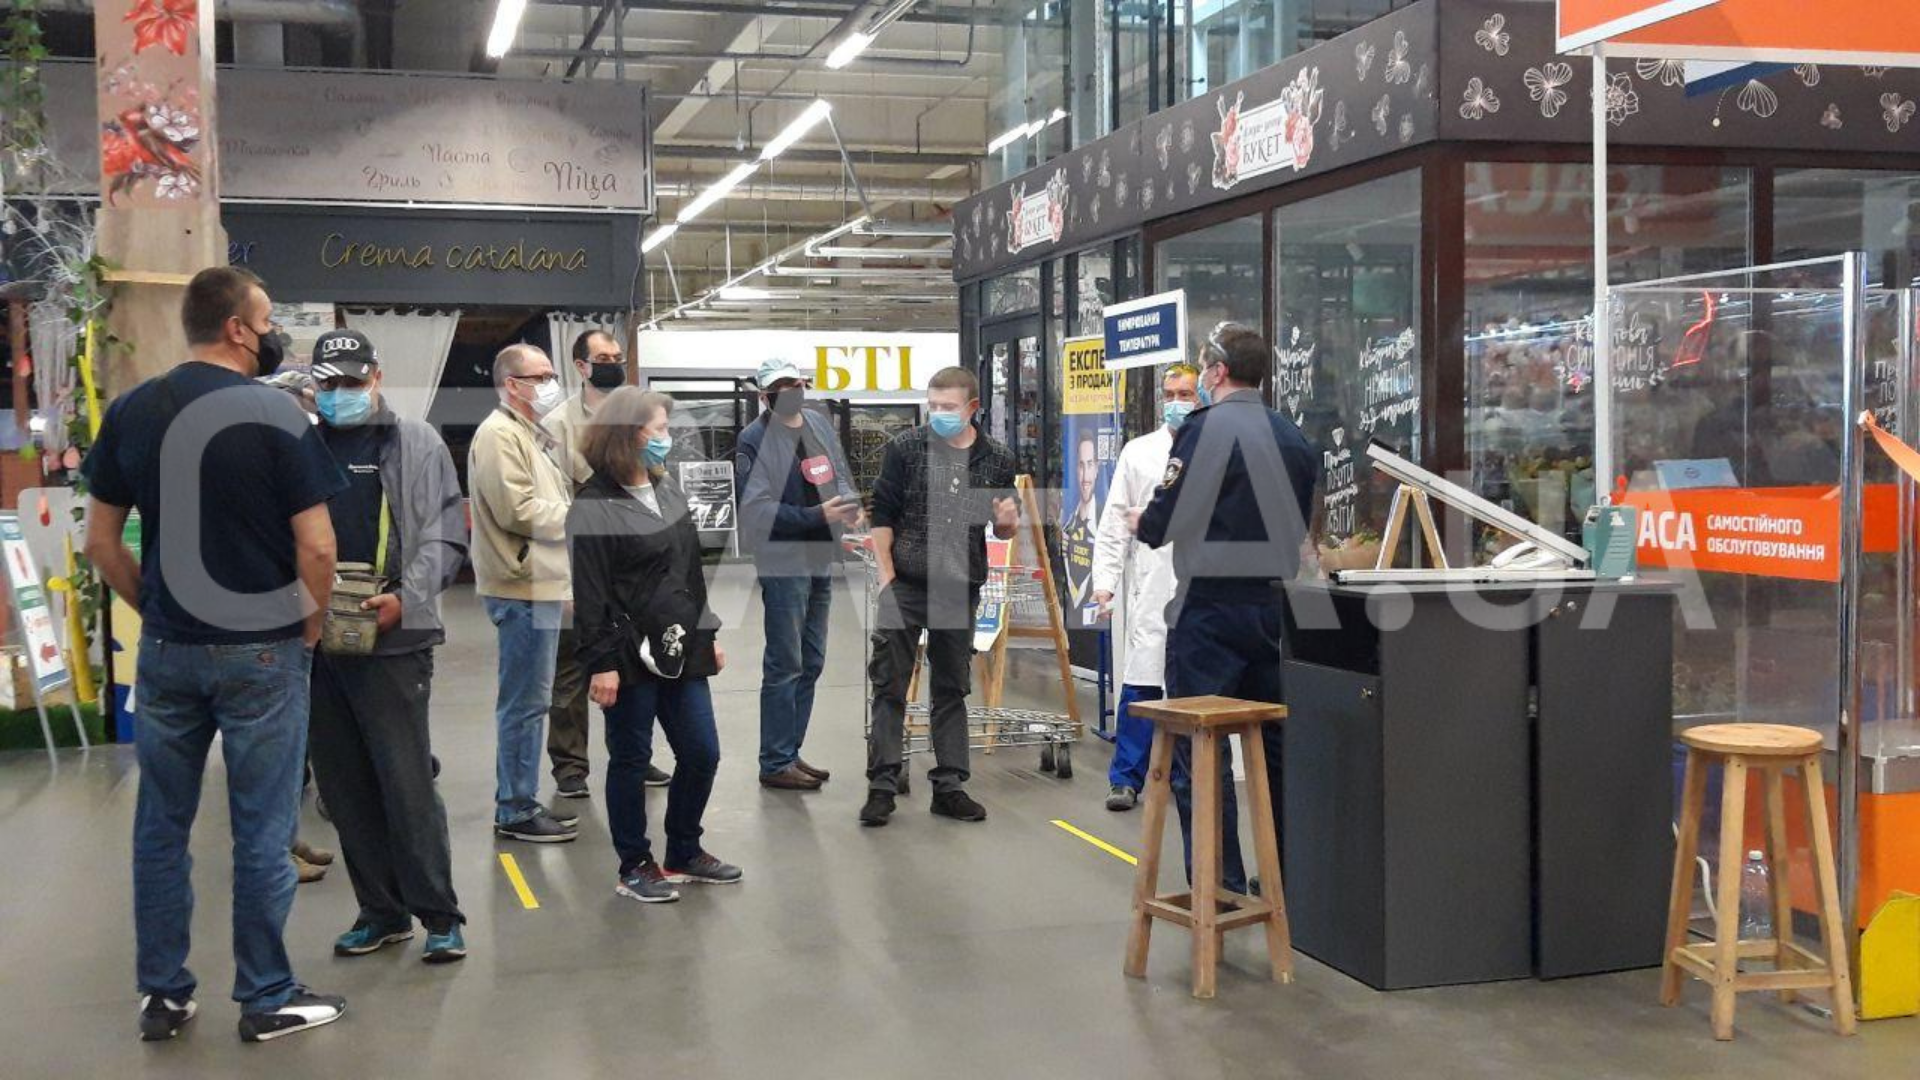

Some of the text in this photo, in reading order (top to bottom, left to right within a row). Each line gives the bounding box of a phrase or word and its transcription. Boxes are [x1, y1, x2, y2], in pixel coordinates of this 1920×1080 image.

[422, 143, 490, 163] Паста
[1243, 131, 1282, 164] БУКЕТ
[362, 166, 421, 192] Гриль
[544, 161, 618, 200] Піца
[228, 240, 257, 264] er
[320, 233, 588, 272] Crema catalana
[814, 345, 916, 391] БТІ
[1069, 348, 1105, 372] ЕКСПЕ
[1637, 510, 1697, 551] АСА
[1707, 514, 1803, 536] САМОСТІЙНОГО
[1707, 537, 1825, 562] ОБСЛУГОВУВАННЯ
